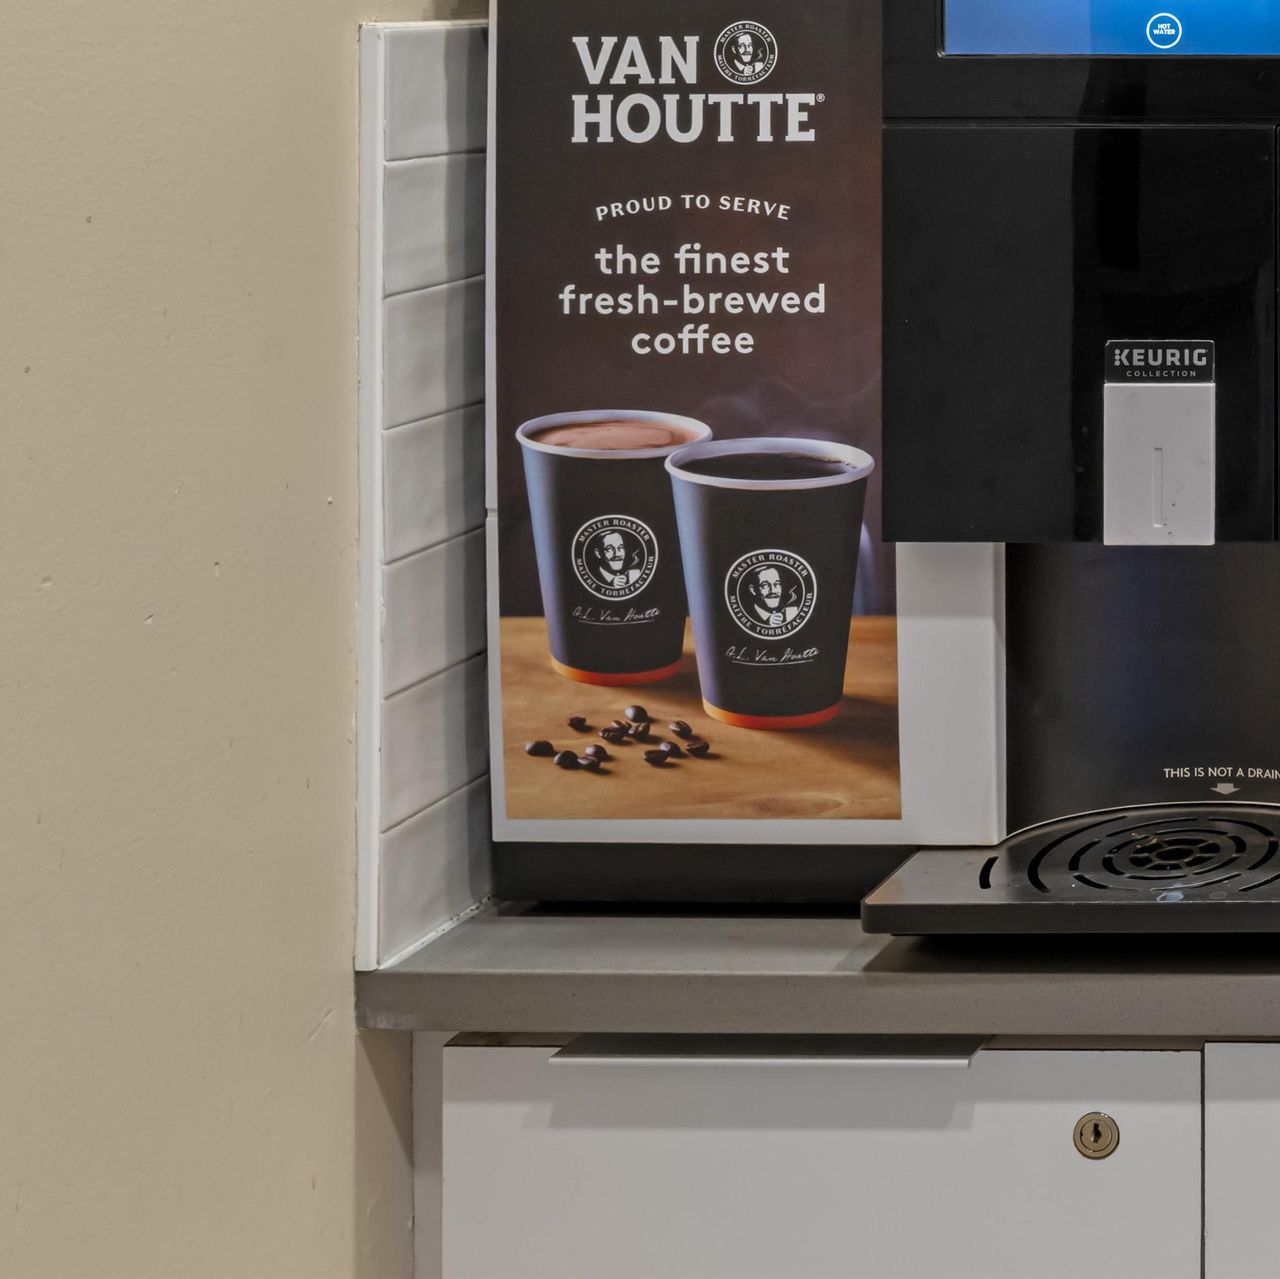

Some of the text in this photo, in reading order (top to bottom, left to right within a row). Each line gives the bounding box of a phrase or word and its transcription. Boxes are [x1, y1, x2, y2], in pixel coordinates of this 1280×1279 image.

[720, 23, 772, 43] MASTER ROASTER
[571, 36, 699, 84] VAN
[595, 194, 791, 222] PROUD TO SERVE
[594, 242, 790, 274] the finest
[558, 283, 826, 315] fresh-brewed
[631, 323, 755, 355] coffee
[1114, 348, 1208, 366] KEURIG
[578, 519, 651, 543] MASTER ROASTER
[731, 553, 809, 579] MASTER ROASTER
[600, 609, 620, 621] Van
[755, 650, 777, 662] Van
[1163, 767, 1191, 778] THIS
[1194, 767, 1204, 777] IS
[1208, 767, 1233, 777] NOT
[1236, 768, 1245, 777] A
